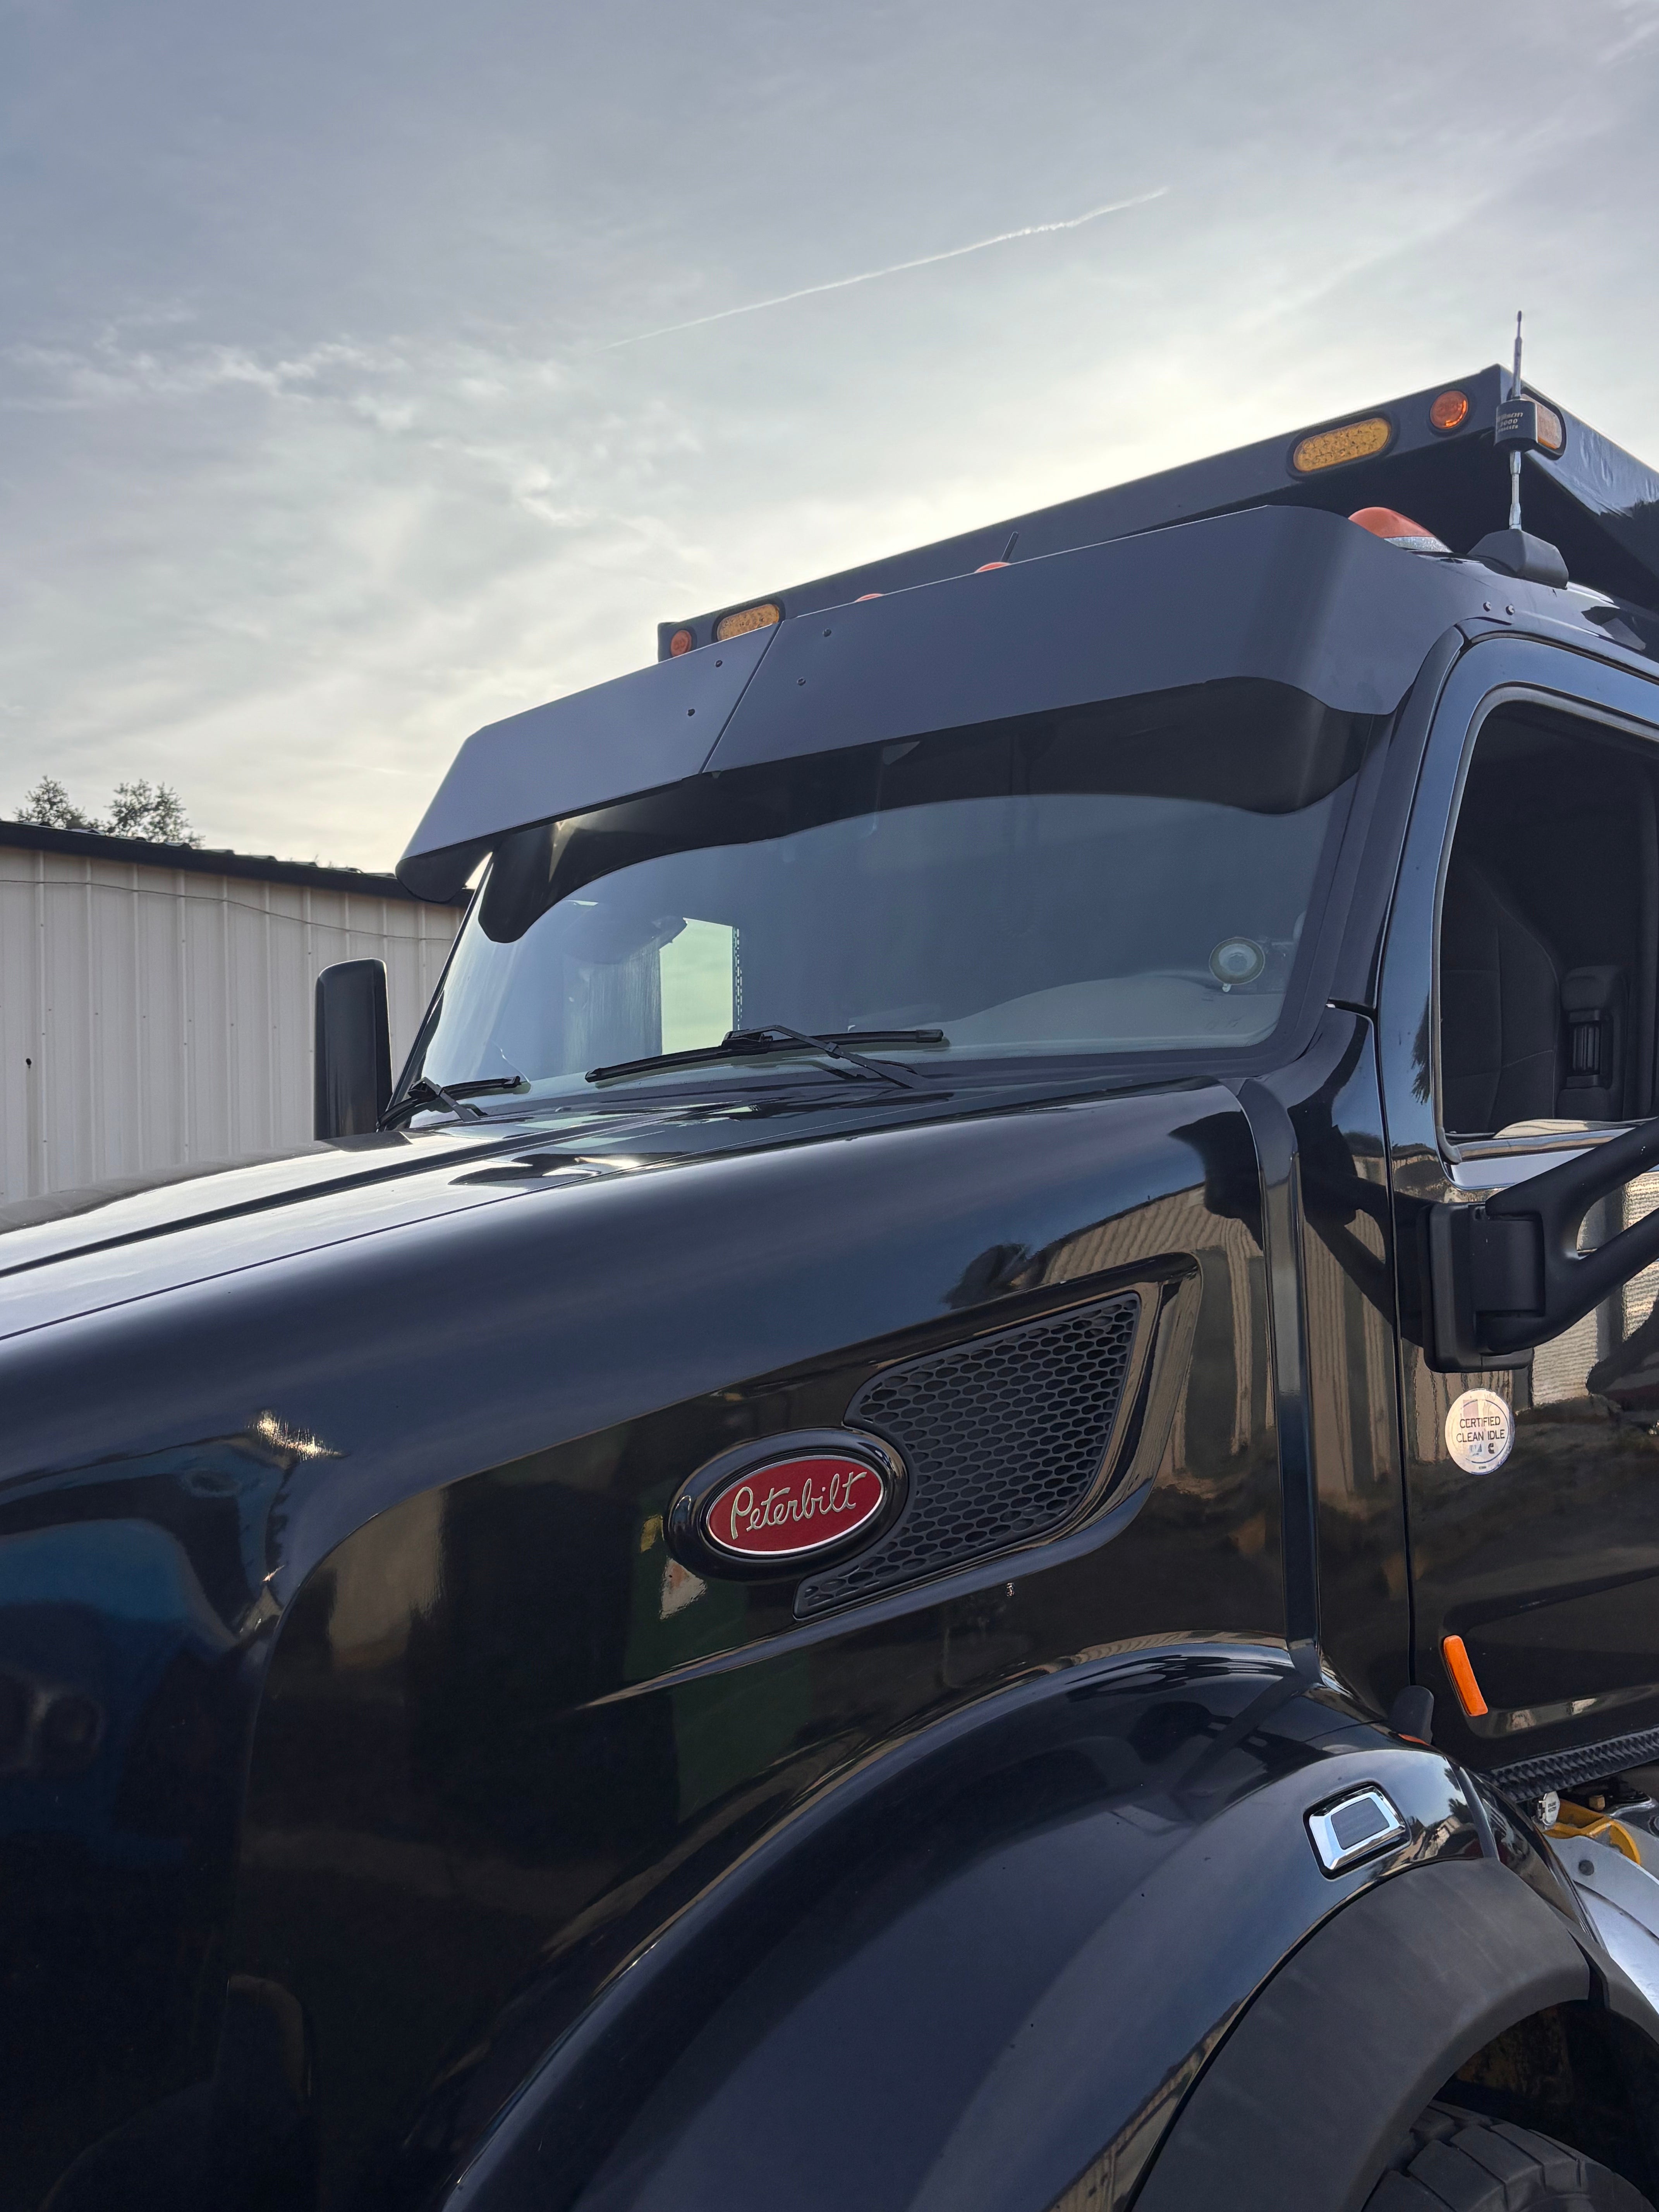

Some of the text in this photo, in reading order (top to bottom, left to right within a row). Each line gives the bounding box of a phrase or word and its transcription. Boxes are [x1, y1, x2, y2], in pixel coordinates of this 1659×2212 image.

[1460, 1416, 1500, 1429] CERTIFIED
[1456, 1429, 1505, 1443] CLEAN IDLE
[731, 1472, 867, 1540] Peterbilt
